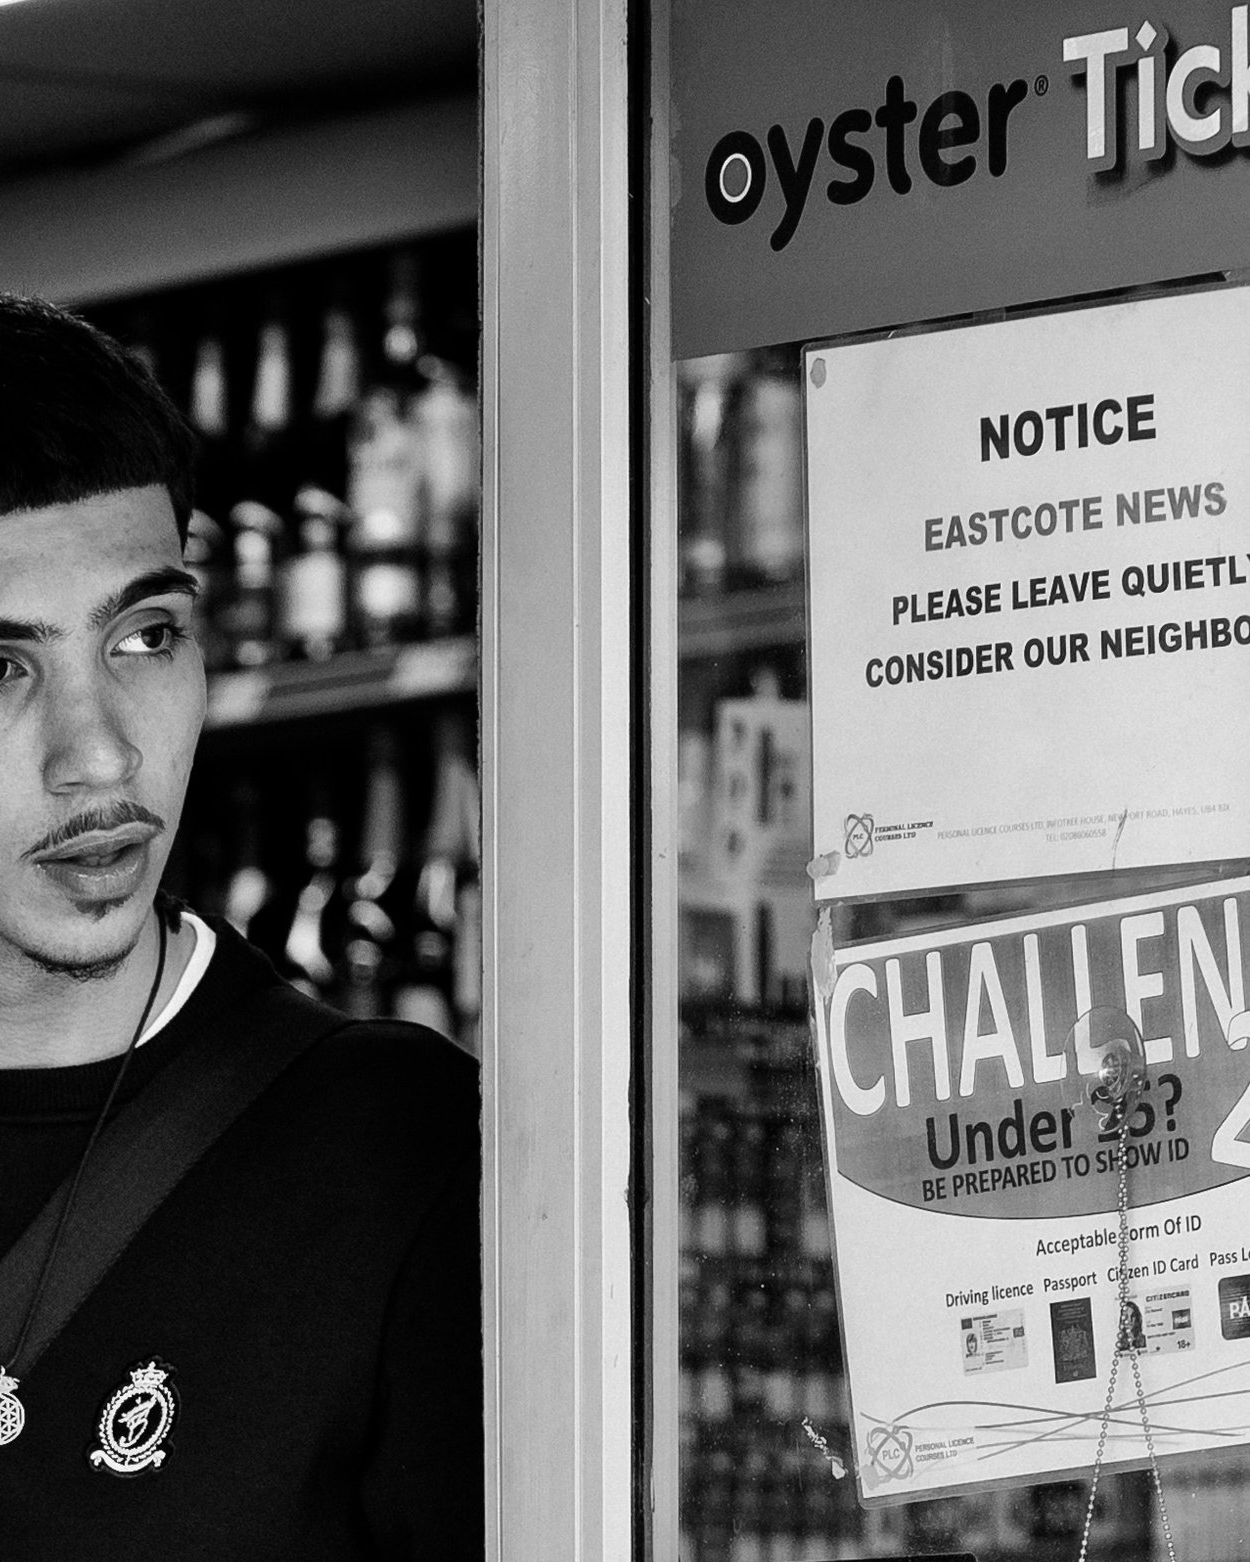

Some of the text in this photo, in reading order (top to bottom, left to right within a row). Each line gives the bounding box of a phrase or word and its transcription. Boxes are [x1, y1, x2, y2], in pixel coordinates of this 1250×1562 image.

[980, 393, 1156, 462] NOTICE
[924, 481, 1228, 552] EASTCOTE NEWS
[892, 582, 1002, 626] PLEASE
[1011, 569, 1111, 611] LEAVE
[865, 641, 1014, 688] CONSIDER
[1023, 632, 1091, 668] OUR
[925, 1098, 1075, 1171] Under
[922, 1138, 1189, 1202] BE PREPARED TO SHOW ID
[1036, 1214, 1203, 1257] Acceptable orm Of ID
[945, 1290, 989, 1308] Driving
[991, 1282, 1034, 1301] licence
[1043, 1271, 1098, 1293] Passport
[1152, 1260, 1167, 1277] ID
[1170, 1253, 1200, 1273] Card
[1209, 1250, 1238, 1267] Pass
[1176, 1339, 1191, 1352] 18+
[882, 1448, 900, 1460] PLC
[914, 1437, 974, 1453] PERSONAL LICENCE
[915, 1449, 958, 1463] COURSES LTD
